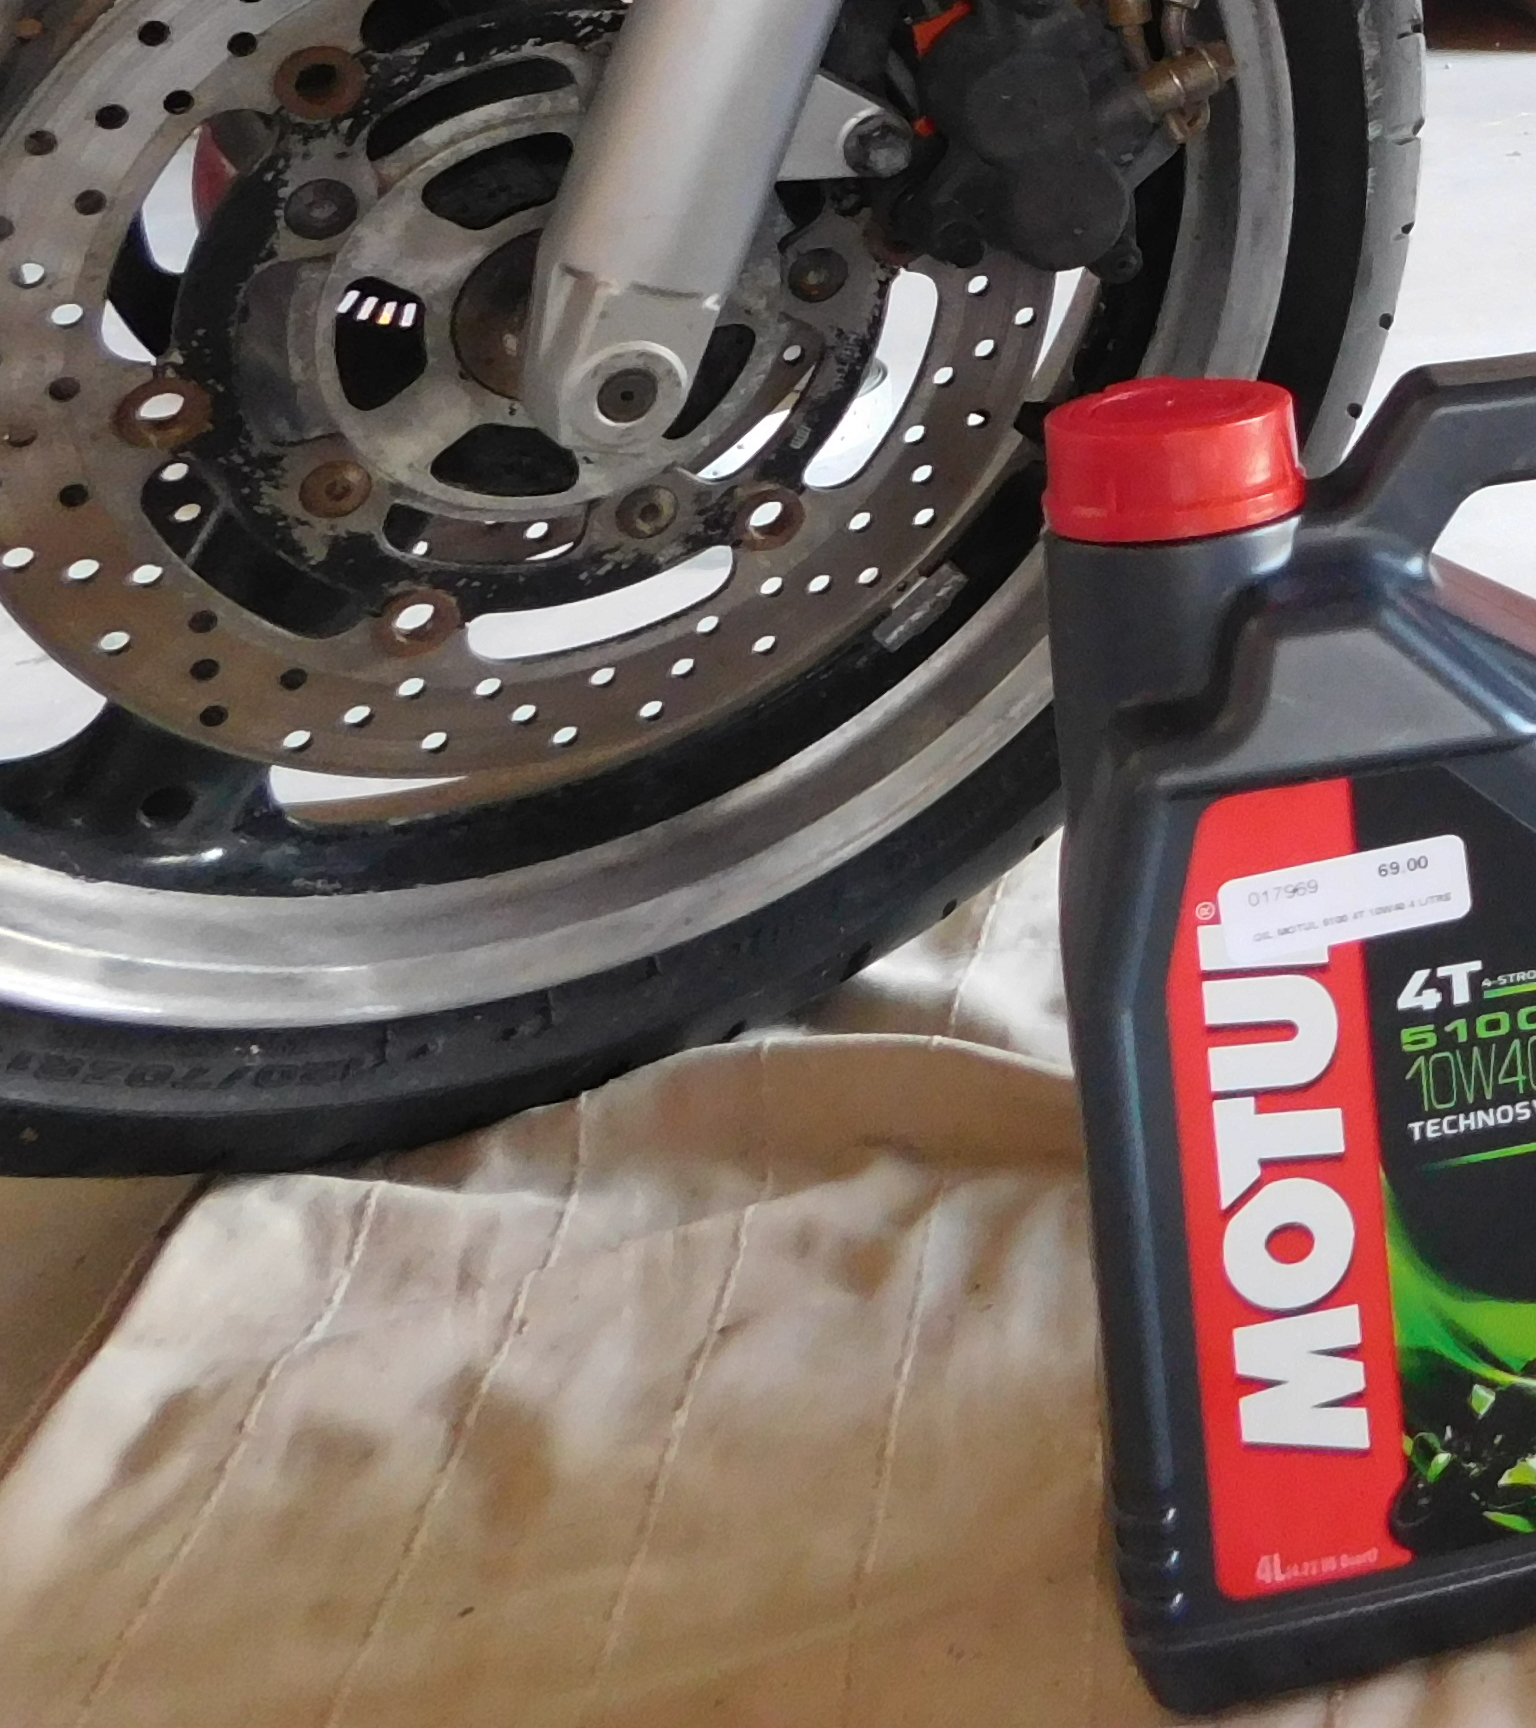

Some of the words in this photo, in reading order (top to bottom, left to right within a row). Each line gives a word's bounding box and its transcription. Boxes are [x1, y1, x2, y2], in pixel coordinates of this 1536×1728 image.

[1247, 878, 1319, 908] 017969
[1376, 854, 1430, 878] 69.00
[1276, 920, 1318, 938] MOTUL
[1417, 891, 1453, 909] LITRE
[1396, 959, 1483, 1012] 4T
